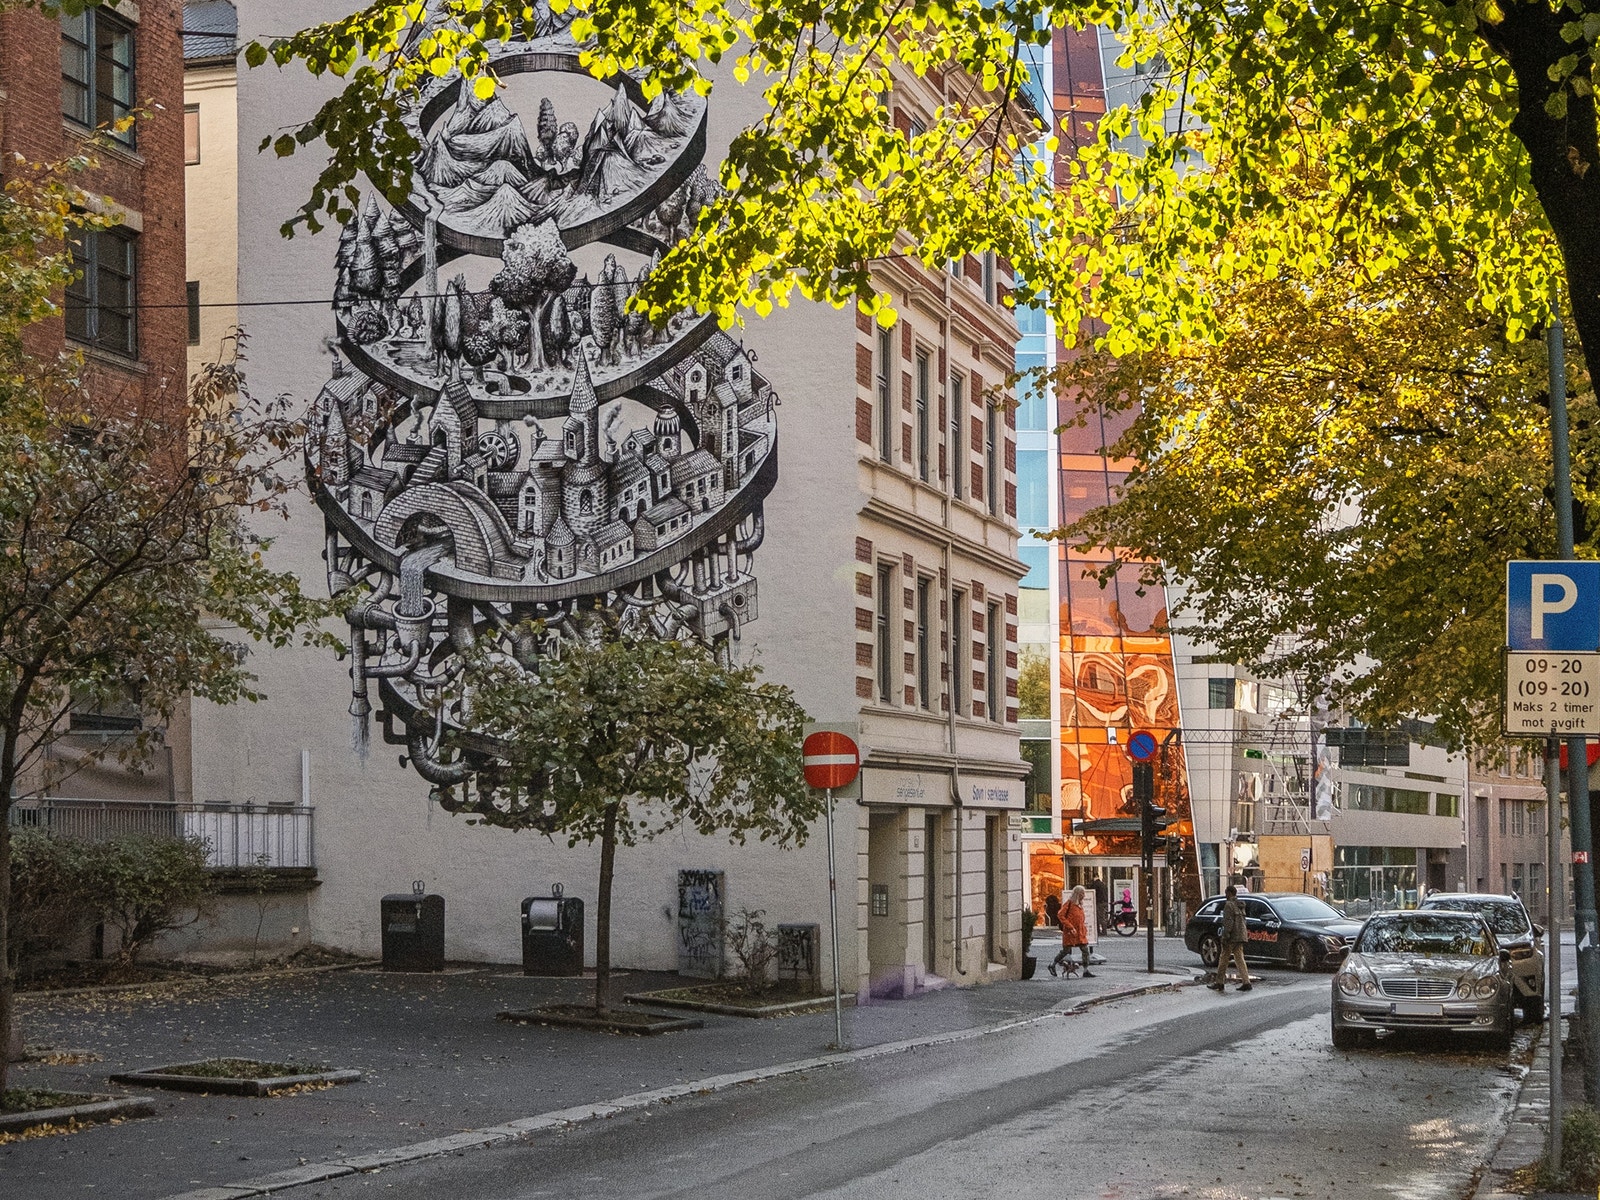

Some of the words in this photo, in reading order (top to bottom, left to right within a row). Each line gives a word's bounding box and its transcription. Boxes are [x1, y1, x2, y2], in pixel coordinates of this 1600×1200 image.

[1531, 574, 1578, 640] P
[1513, 702, 1543, 712] Maks
[1550, 702, 1557, 712] 2
[1564, 702, 1594, 713] timer
[1521, 718, 1544, 728] mot
[1551, 717, 1585, 731] avgift
